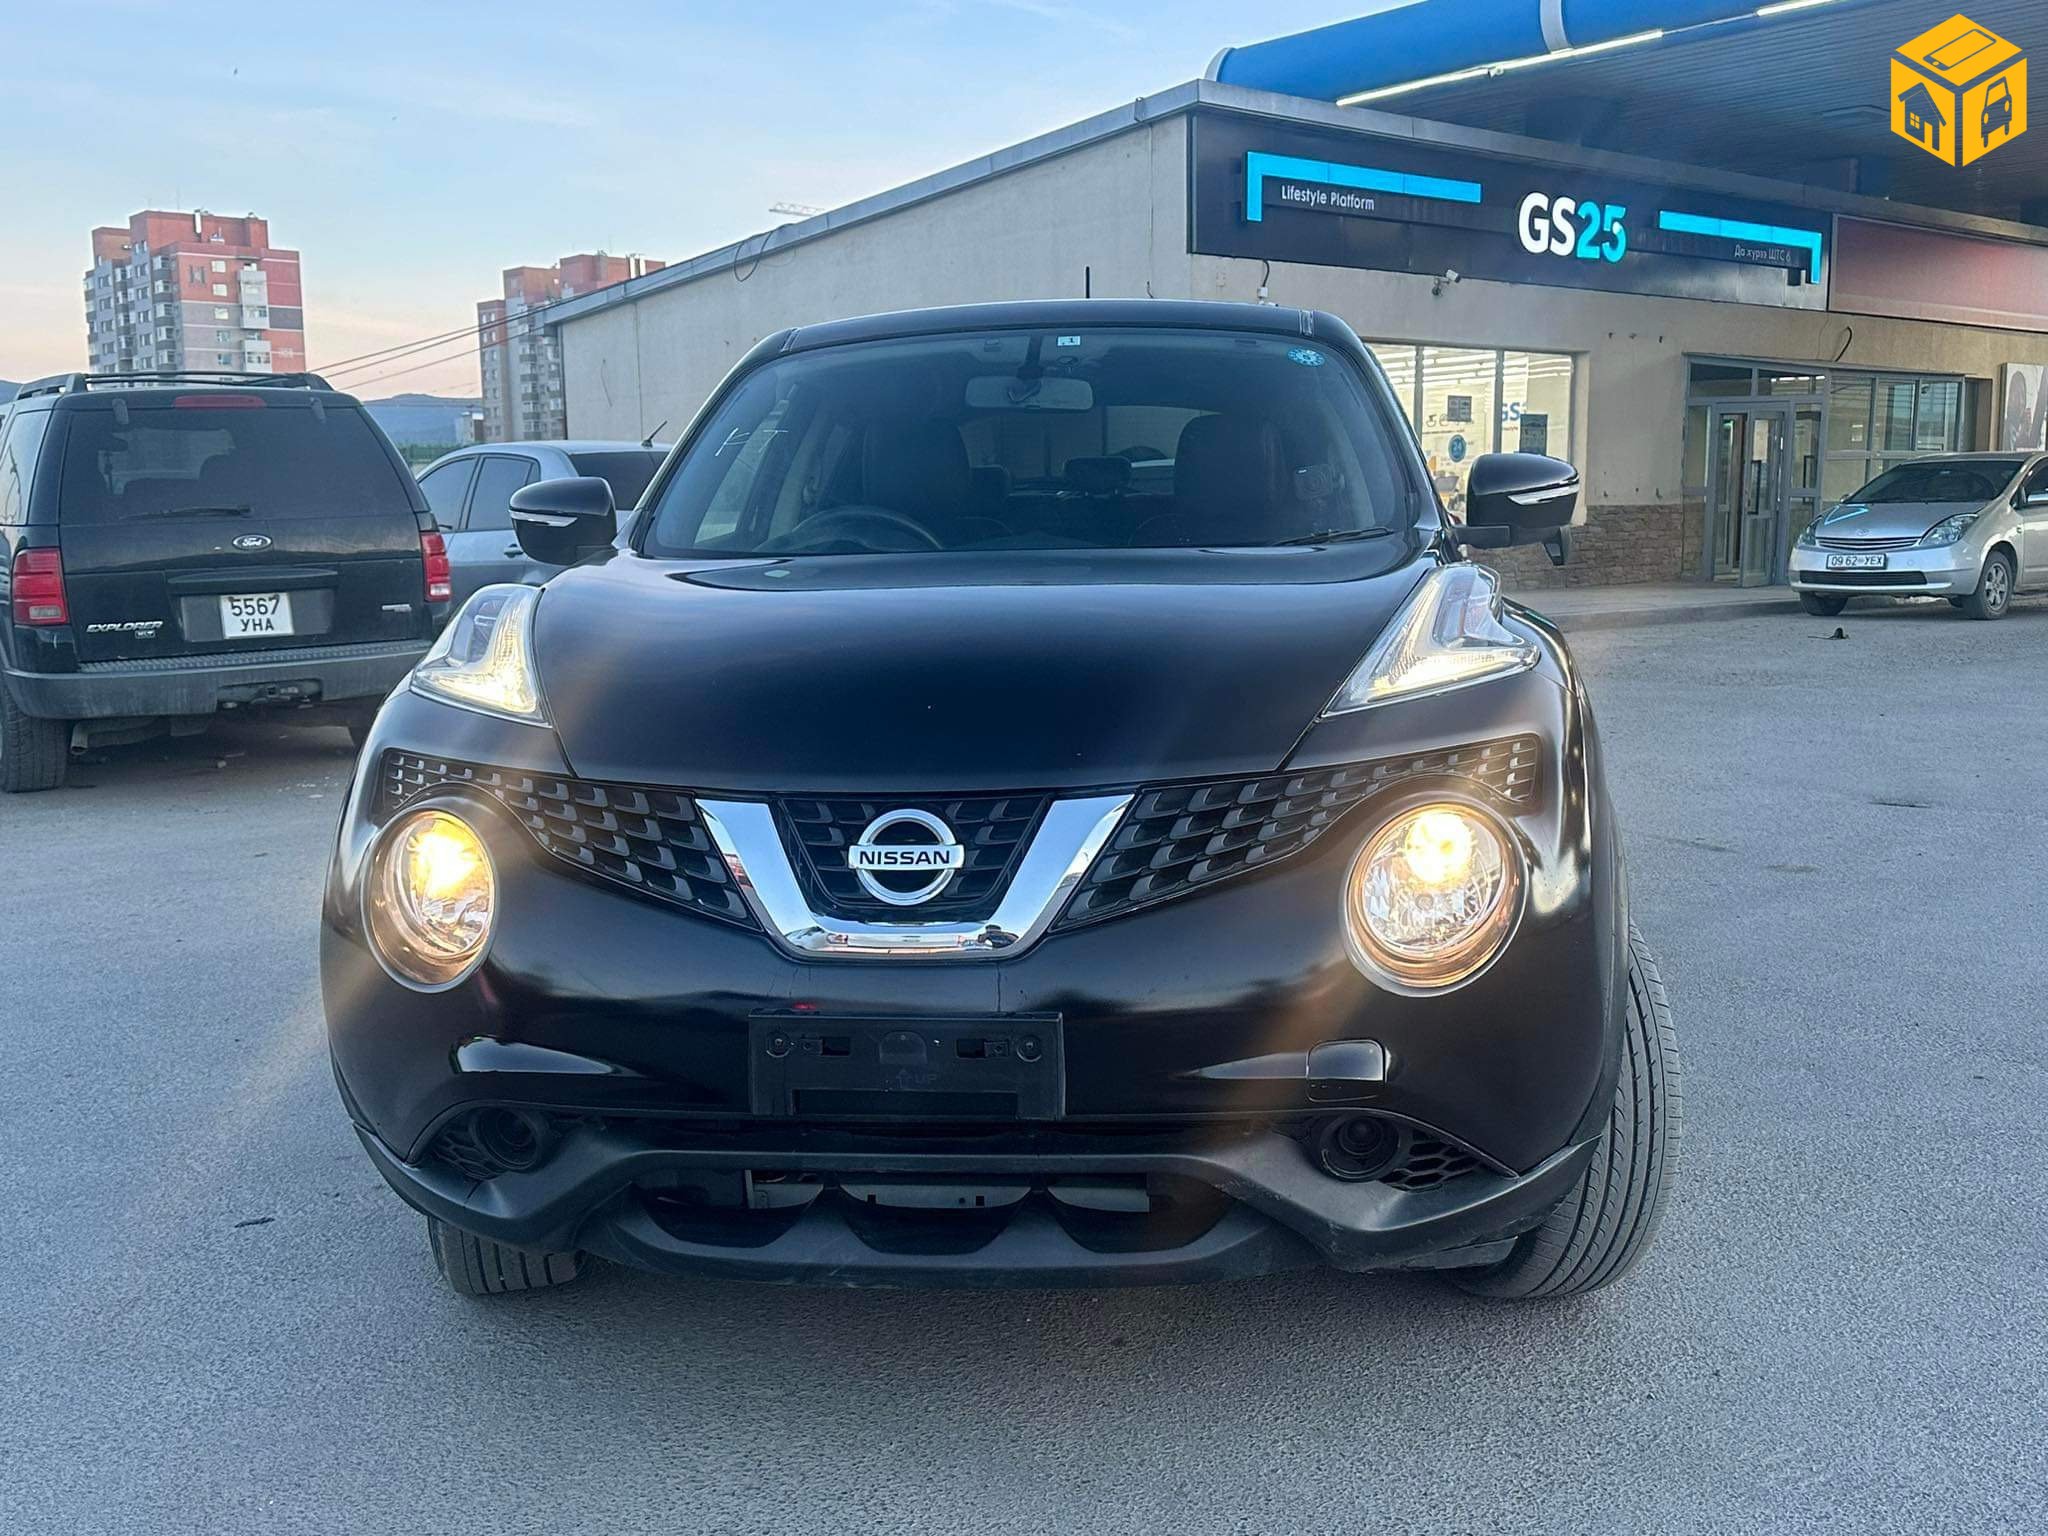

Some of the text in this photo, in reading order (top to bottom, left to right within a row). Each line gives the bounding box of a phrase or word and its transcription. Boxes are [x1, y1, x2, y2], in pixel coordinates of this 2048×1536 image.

[1281, 185, 1375, 211] Lifestyle Platform
[1518, 192, 1627, 263] GS25
[229, 595, 280, 616] 5567
[86, 620, 164, 632] EXPLORER
[859, 850, 950, 865] NISSAN
